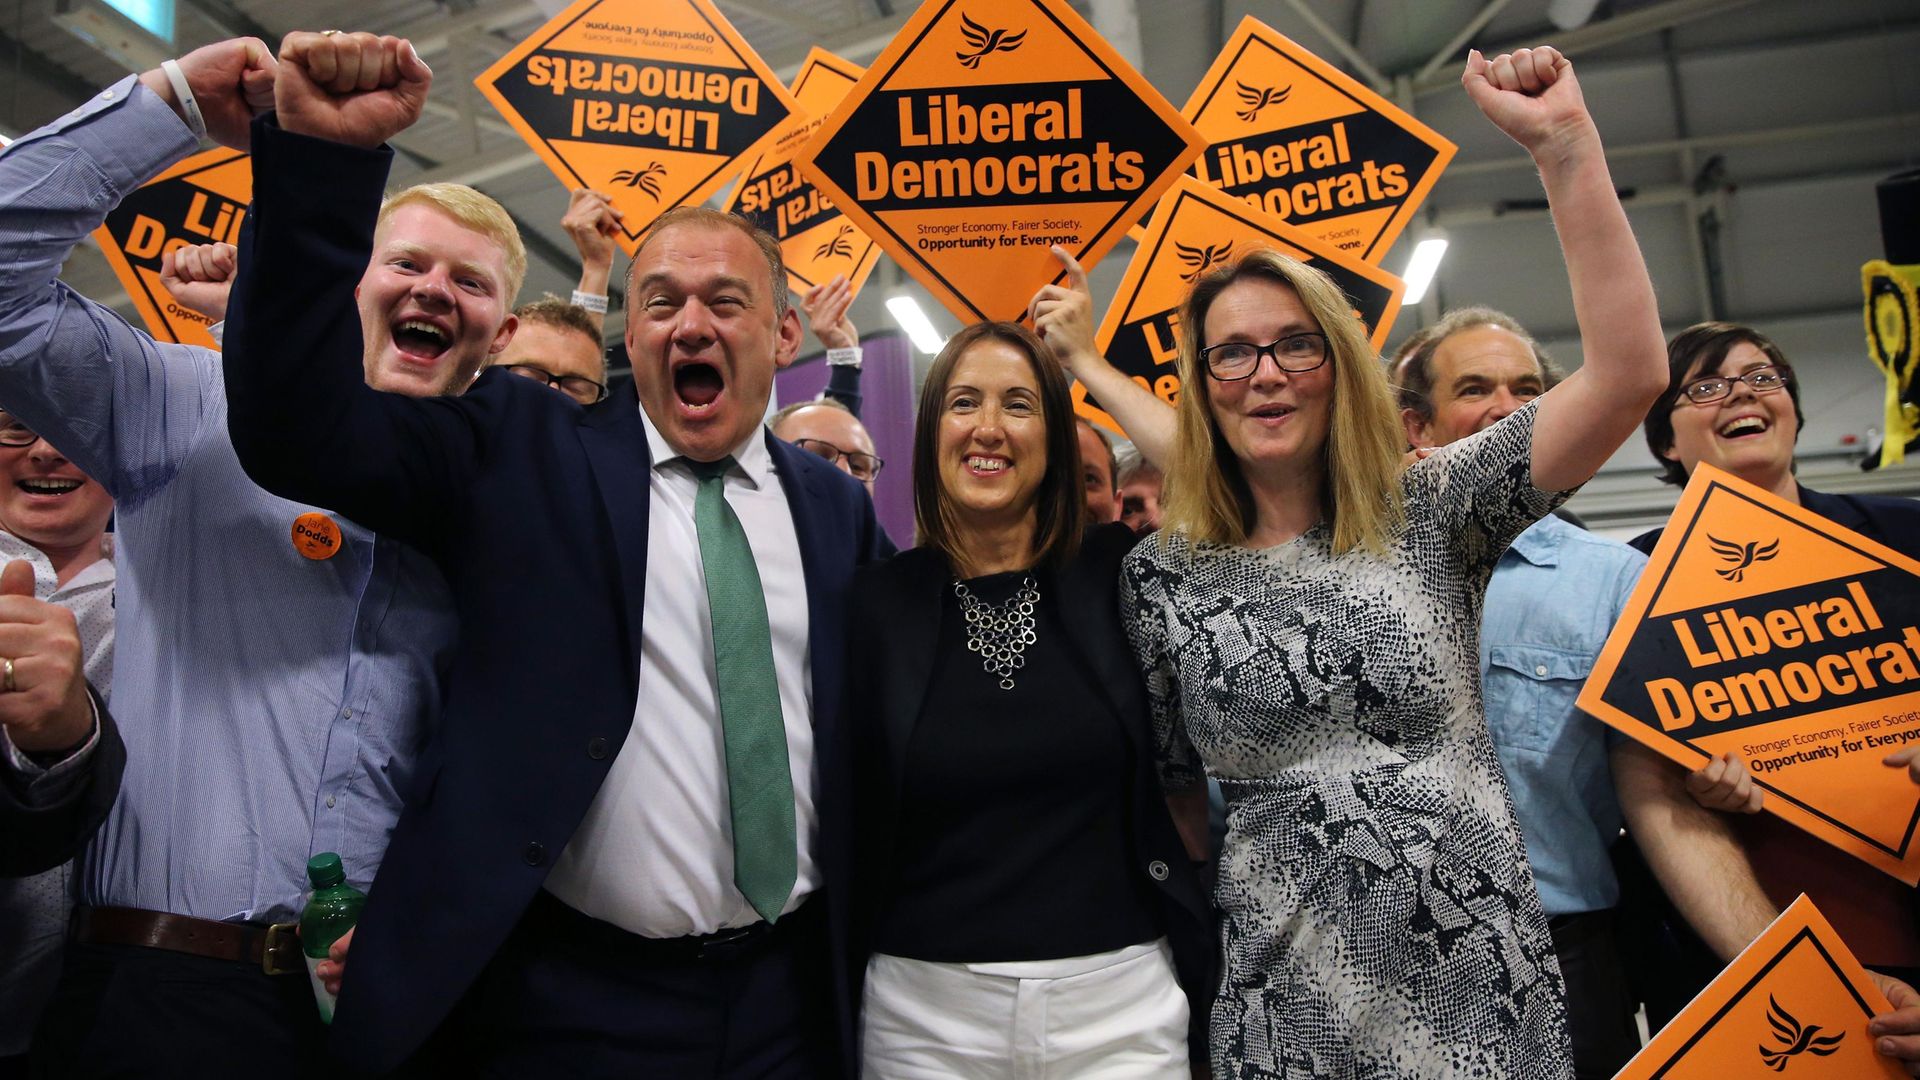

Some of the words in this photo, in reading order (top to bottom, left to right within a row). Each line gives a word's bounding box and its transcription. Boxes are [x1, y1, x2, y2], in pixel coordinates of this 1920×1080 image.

[634, 25, 649, 36] for
[526, 55, 759, 116] Democrats
[571, 98, 719, 151] Liberal
[898, 88, 1083, 147] Liberal
[854, 142, 1145, 201] Democrats
[1194, 121, 1351, 190] Liberal
[917, 223, 959, 236] Stronger
[962, 222, 1009, 233] Economy.
[1012, 220, 1040, 231] Fairer
[1043, 219, 1083, 231] Society.
[918, 236, 996, 252] Opportunity
[999, 234, 1018, 246] for
[1021, 233, 1083, 248] Everyone.
[296, 524, 335, 547] Dodds
[1671, 580, 1884, 669] Liberal
[1743, 737, 1791, 757] Stronger
[1793, 726, 1848, 746] Economy.
[1849, 719, 1881, 734] Fairer
[1750, 745, 1839, 773] Opportunity
[1841, 739, 1863, 754] for
